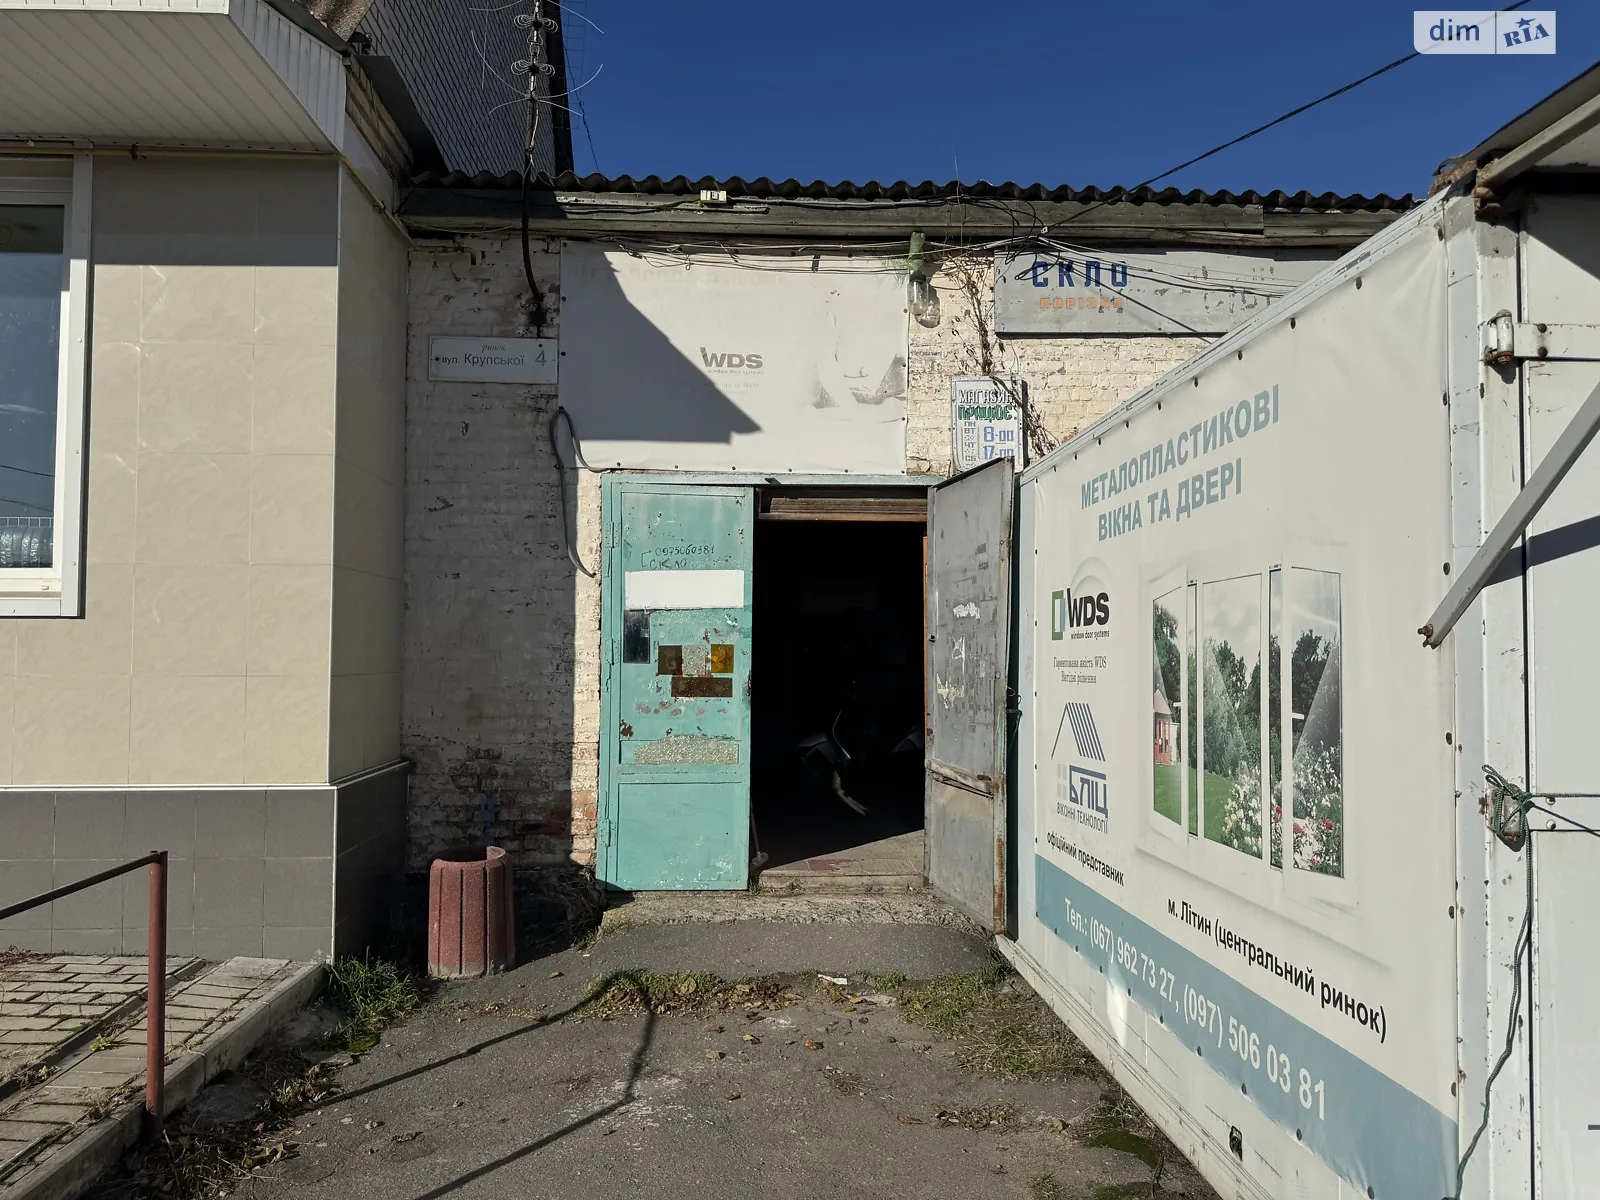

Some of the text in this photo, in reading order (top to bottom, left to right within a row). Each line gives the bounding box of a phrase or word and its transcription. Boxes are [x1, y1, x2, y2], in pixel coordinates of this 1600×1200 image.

[1032, 260, 1127, 287] СКЛО
[442, 350, 547, 367] вул. Крупської 4
[700, 346, 763, 369] WDS
[1081, 384, 1279, 509] МЕТАЛОПЛАСТИКОВІ
[1098, 457, 1242, 541] ВІКНА ТА ДВЕРІ
[1066, 588, 1109, 628] WDS
[1071, 629, 1109, 640] window door systems
[1047, 831, 1124, 886] офіційний представник
[1168, 898, 1387, 1044] м. Літин (центральний ринок)
[1065, 898, 1325, 1120] Тел.: (067) 962 73 27, (097) 506 03 81
